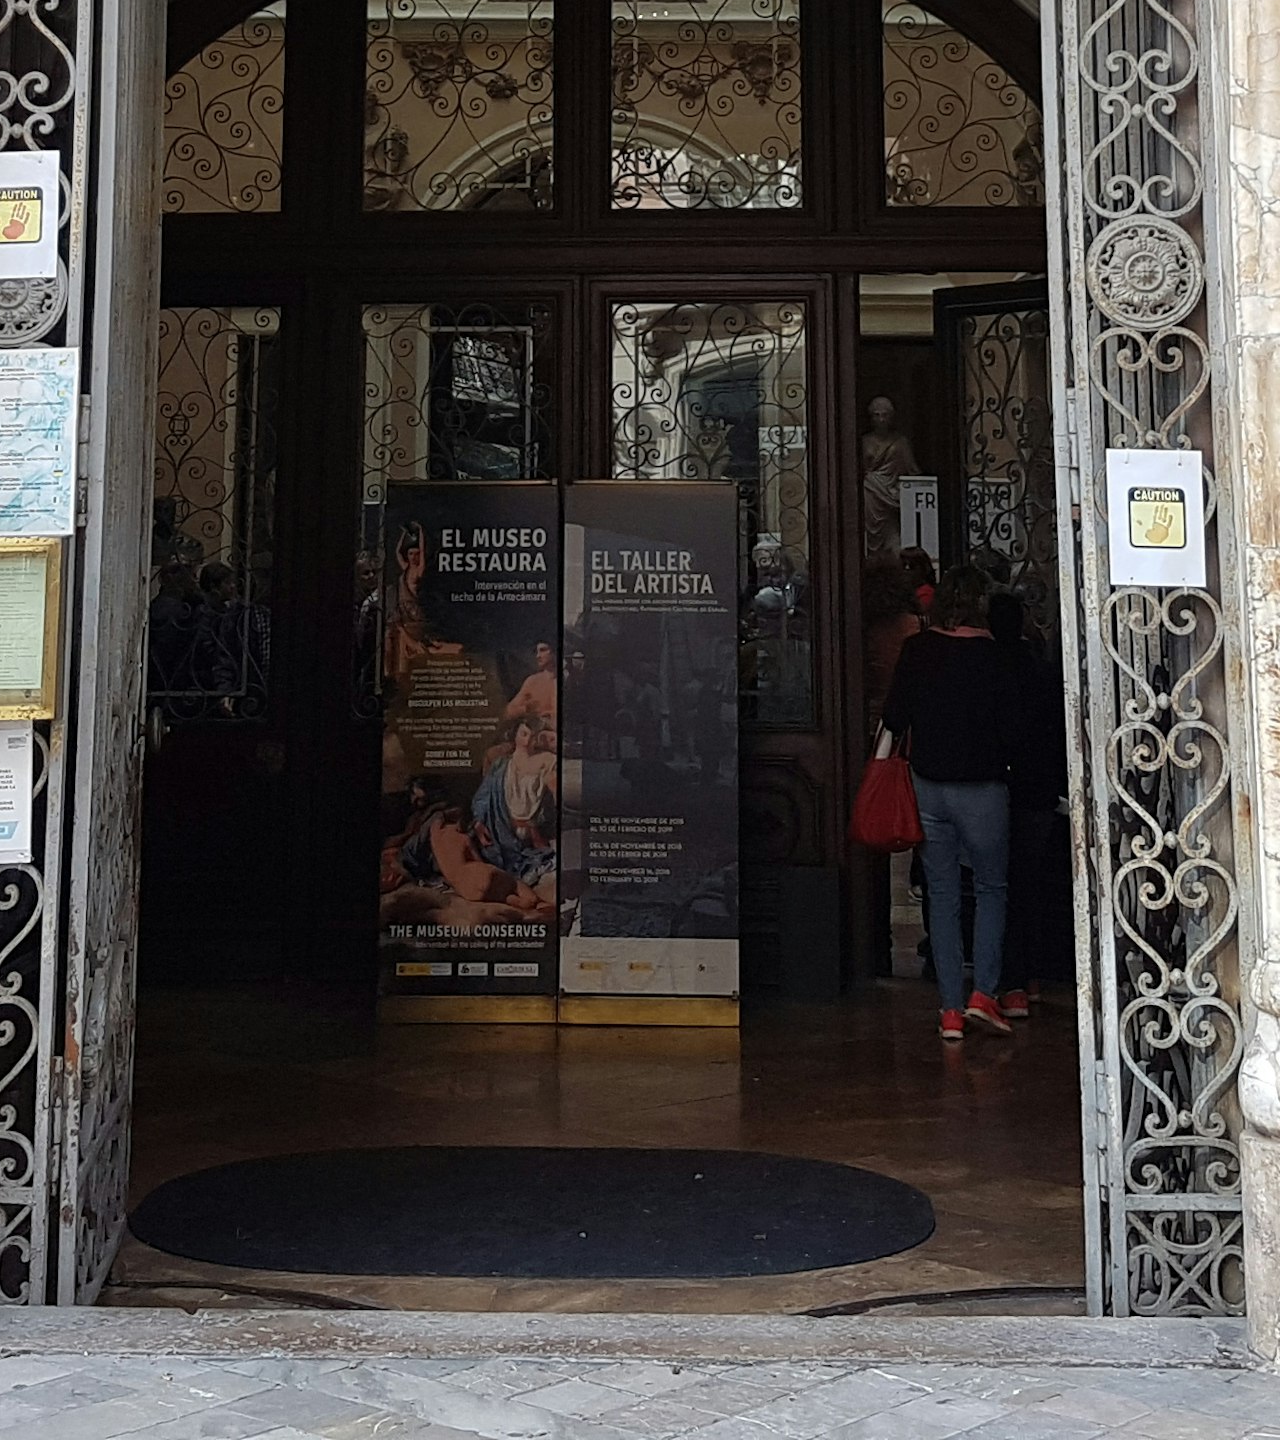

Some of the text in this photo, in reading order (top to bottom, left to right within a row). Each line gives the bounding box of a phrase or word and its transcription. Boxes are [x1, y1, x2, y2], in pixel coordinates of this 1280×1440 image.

[1133, 489, 1180, 501] CAUTION
[442, 527, 547, 548] EL MUSEO
[438, 552, 547, 572] RESTAURA
[591, 550, 692, 572] EL TALLER
[474, 580, 525, 591] Intervención
[526, 582, 537, 590] en
[591, 573, 714, 594] DEL ARTISTA
[475, 592, 487, 601] de
[389, 924, 547, 938] THE MUSEUM CONSERVES
